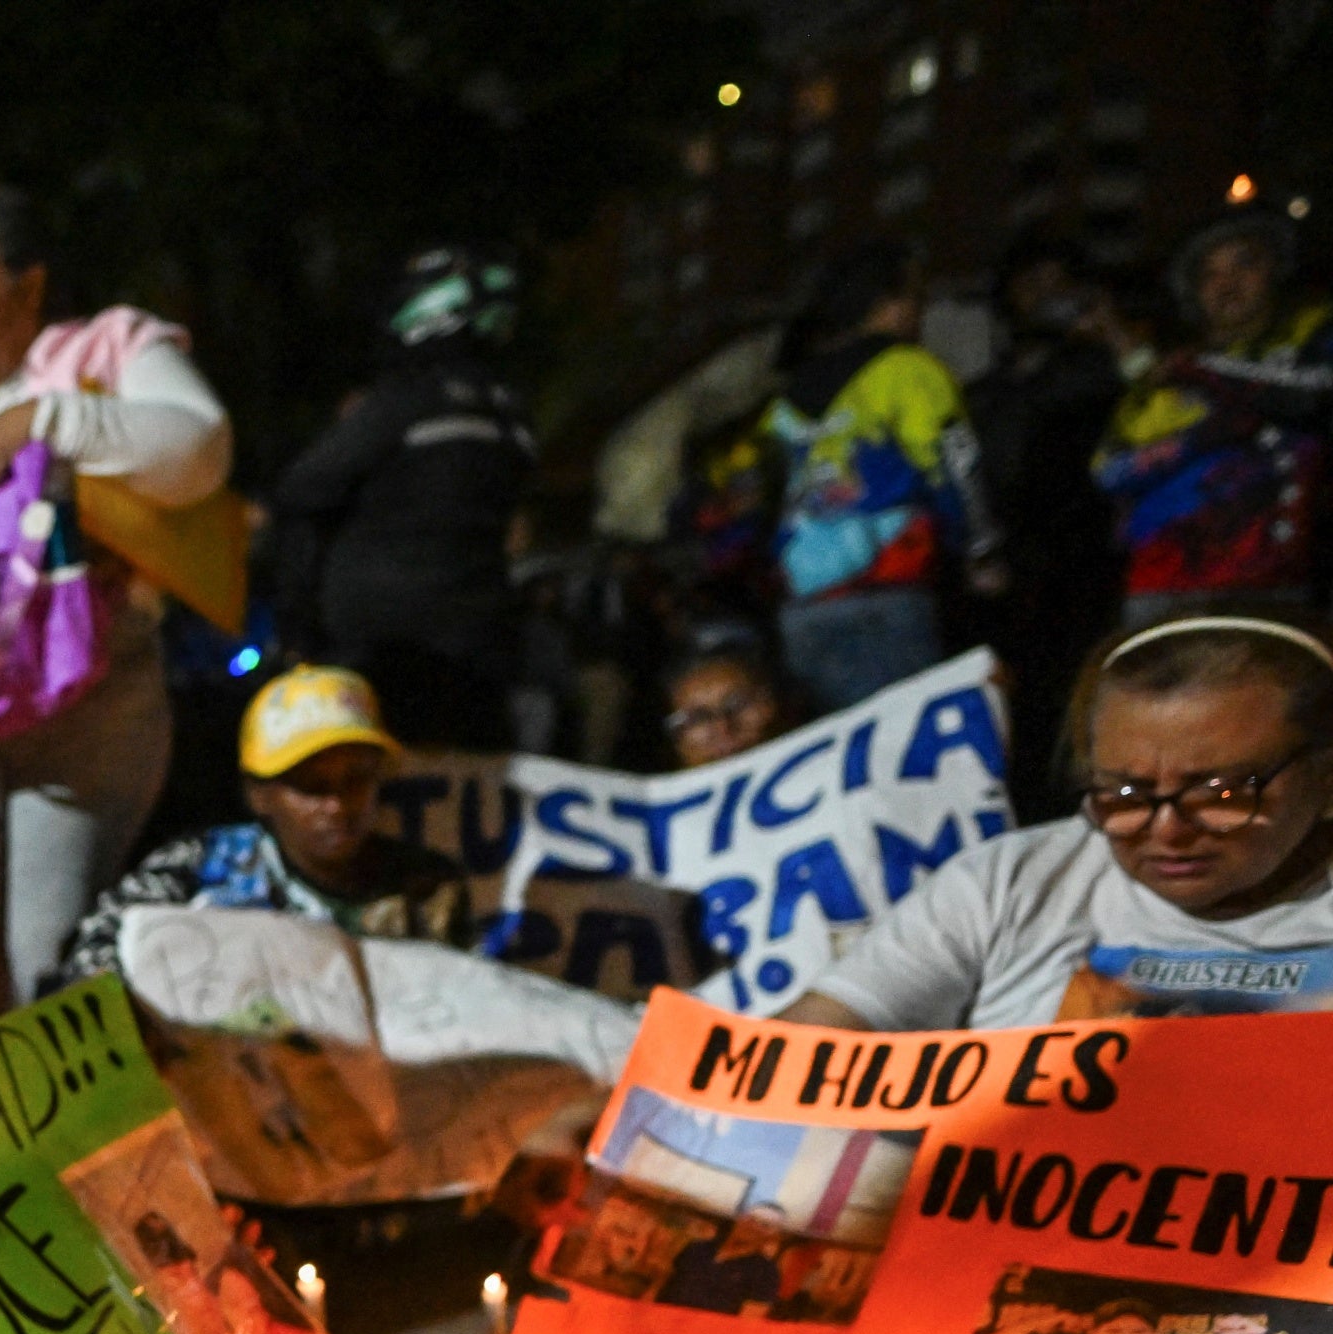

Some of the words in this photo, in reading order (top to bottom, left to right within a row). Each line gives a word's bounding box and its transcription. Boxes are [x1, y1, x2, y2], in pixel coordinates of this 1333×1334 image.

[691, 1025, 786, 1102] MI
[800, 1041, 988, 1110] HIJO
[1005, 1031, 1130, 1112] ES
[921, 1145, 1333, 1267] INOCENT
